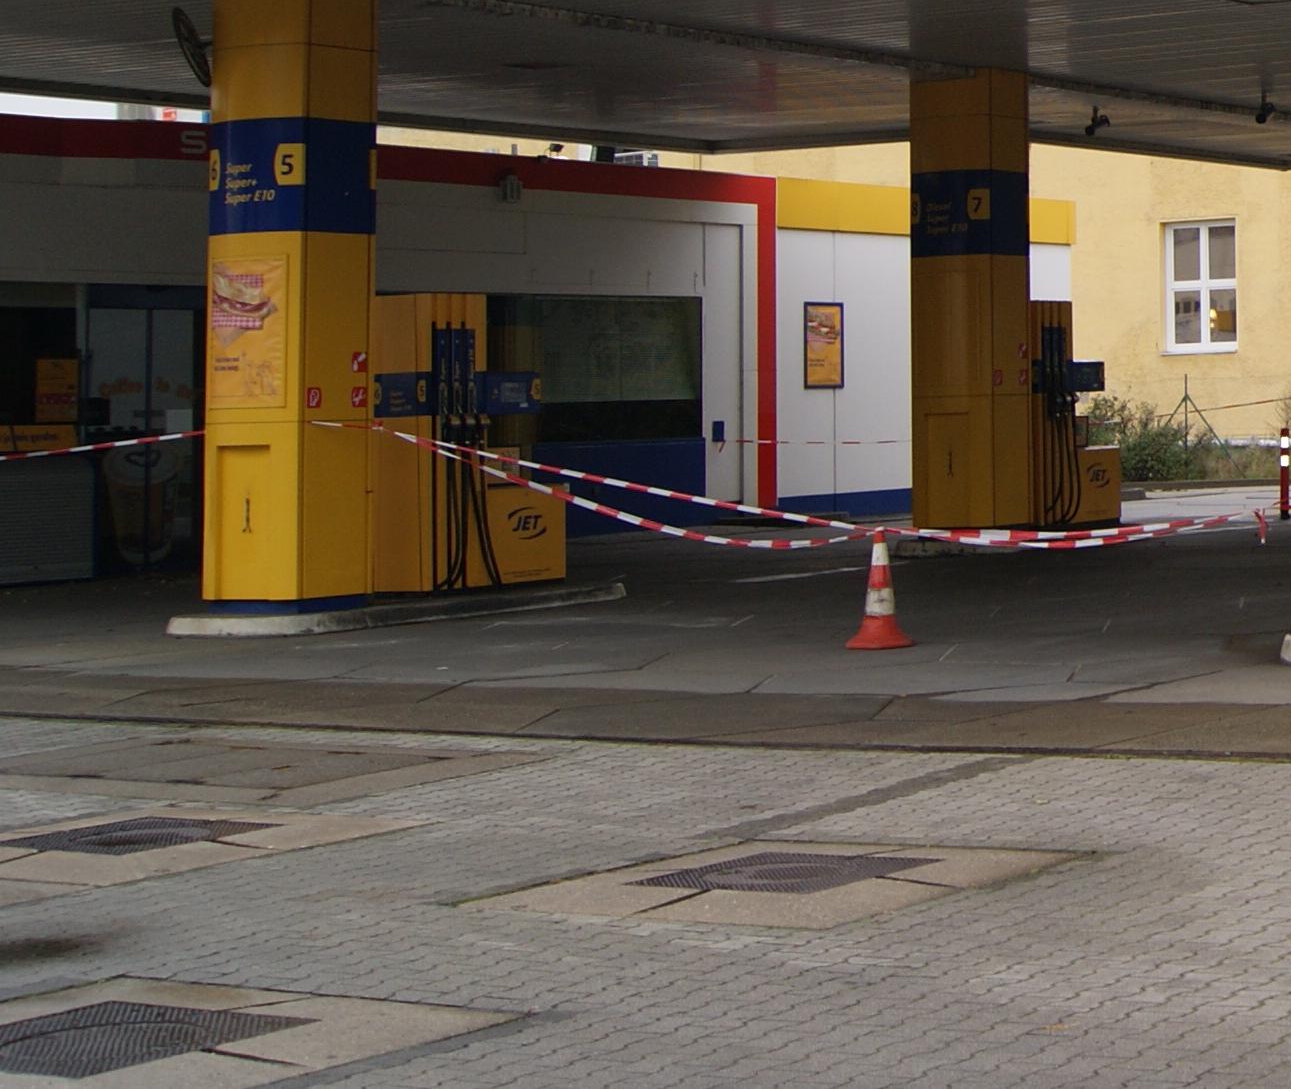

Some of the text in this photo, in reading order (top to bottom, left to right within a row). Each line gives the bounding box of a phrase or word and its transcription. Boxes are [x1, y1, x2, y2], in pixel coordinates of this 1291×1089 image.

[225, 162, 252, 176] Super
[280, 154, 294, 176] 5
[224, 189, 276, 206] Super E10
[972, 197, 983, 213] 7
[1090, 469, 1106, 482] JET
[512, 514, 542, 532] JET
